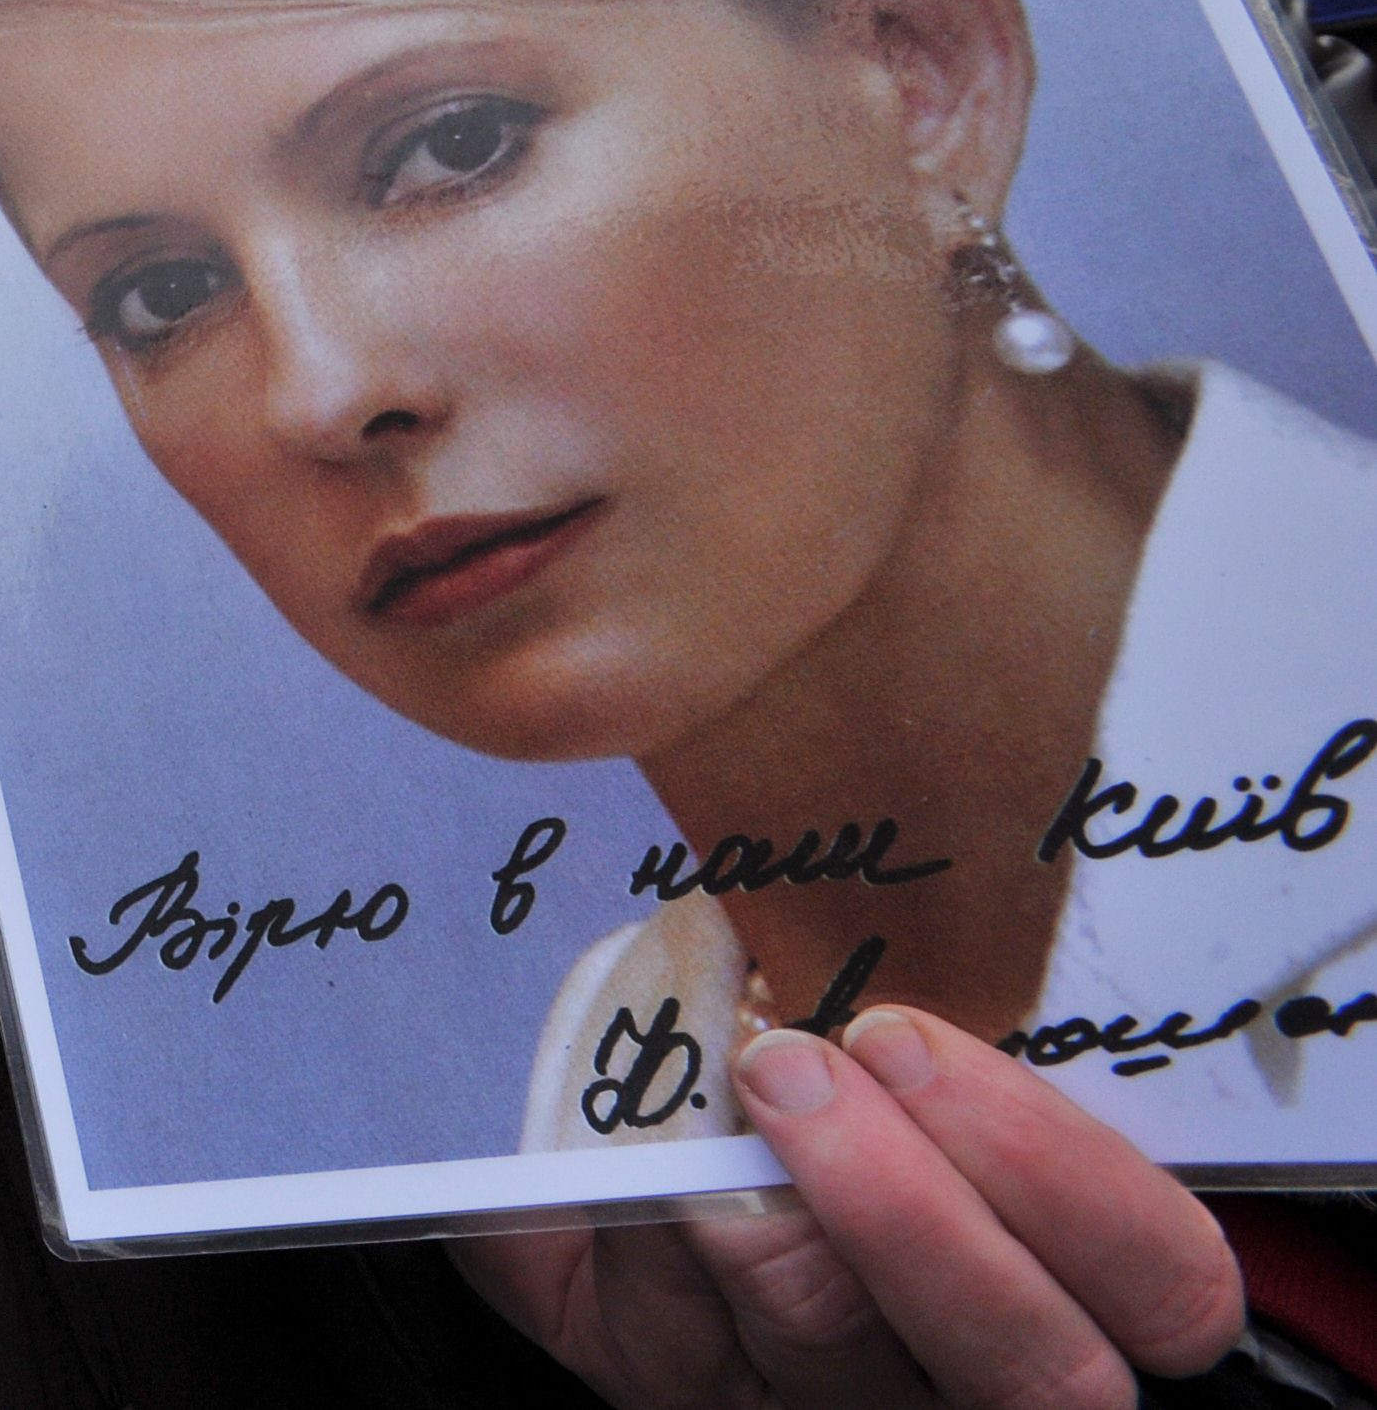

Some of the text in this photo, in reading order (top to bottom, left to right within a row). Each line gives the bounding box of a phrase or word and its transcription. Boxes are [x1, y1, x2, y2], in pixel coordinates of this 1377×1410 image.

[68, 717, 1377, 1004] Вірю в наш Київ
